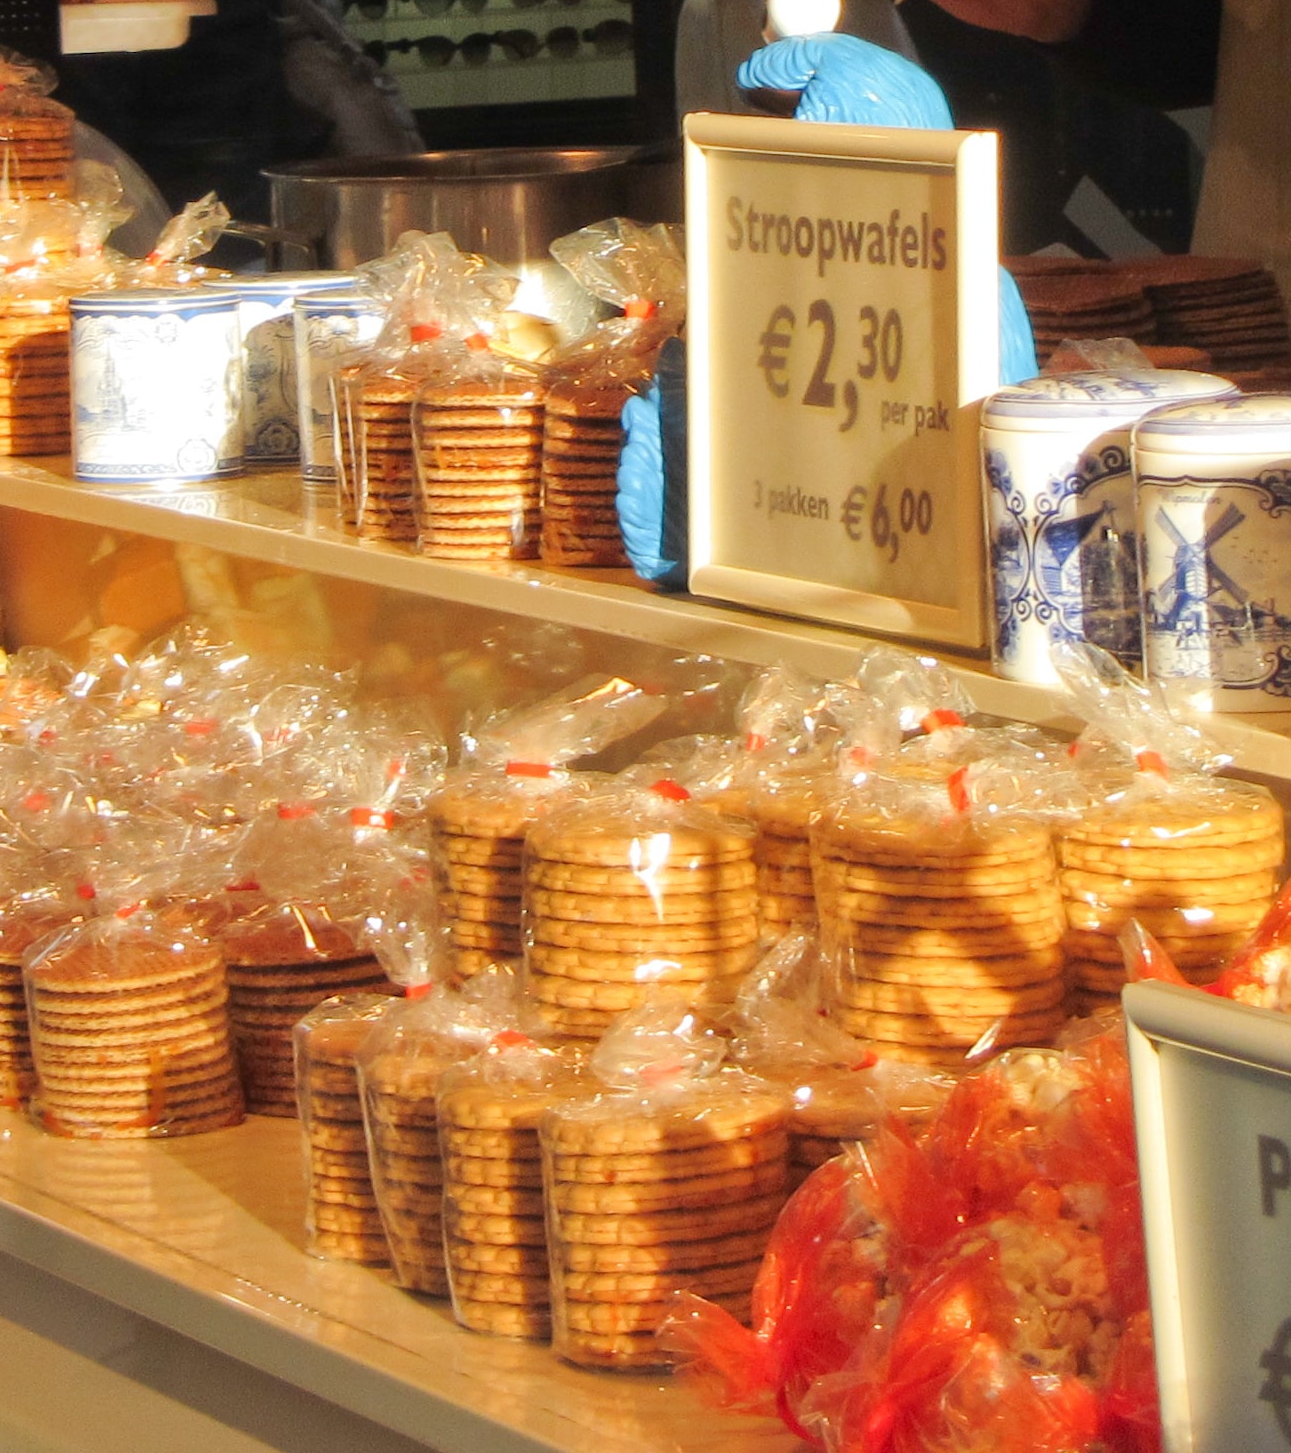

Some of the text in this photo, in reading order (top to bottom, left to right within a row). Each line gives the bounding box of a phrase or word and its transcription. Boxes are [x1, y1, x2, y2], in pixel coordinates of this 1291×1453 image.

[726, 196, 947, 278] Stroopwafels
[758, 299, 903, 432] €2,30
[881, 399, 949, 436] per pak
[768, 485, 829, 521] pakken
[840, 482, 933, 563] €6,00
